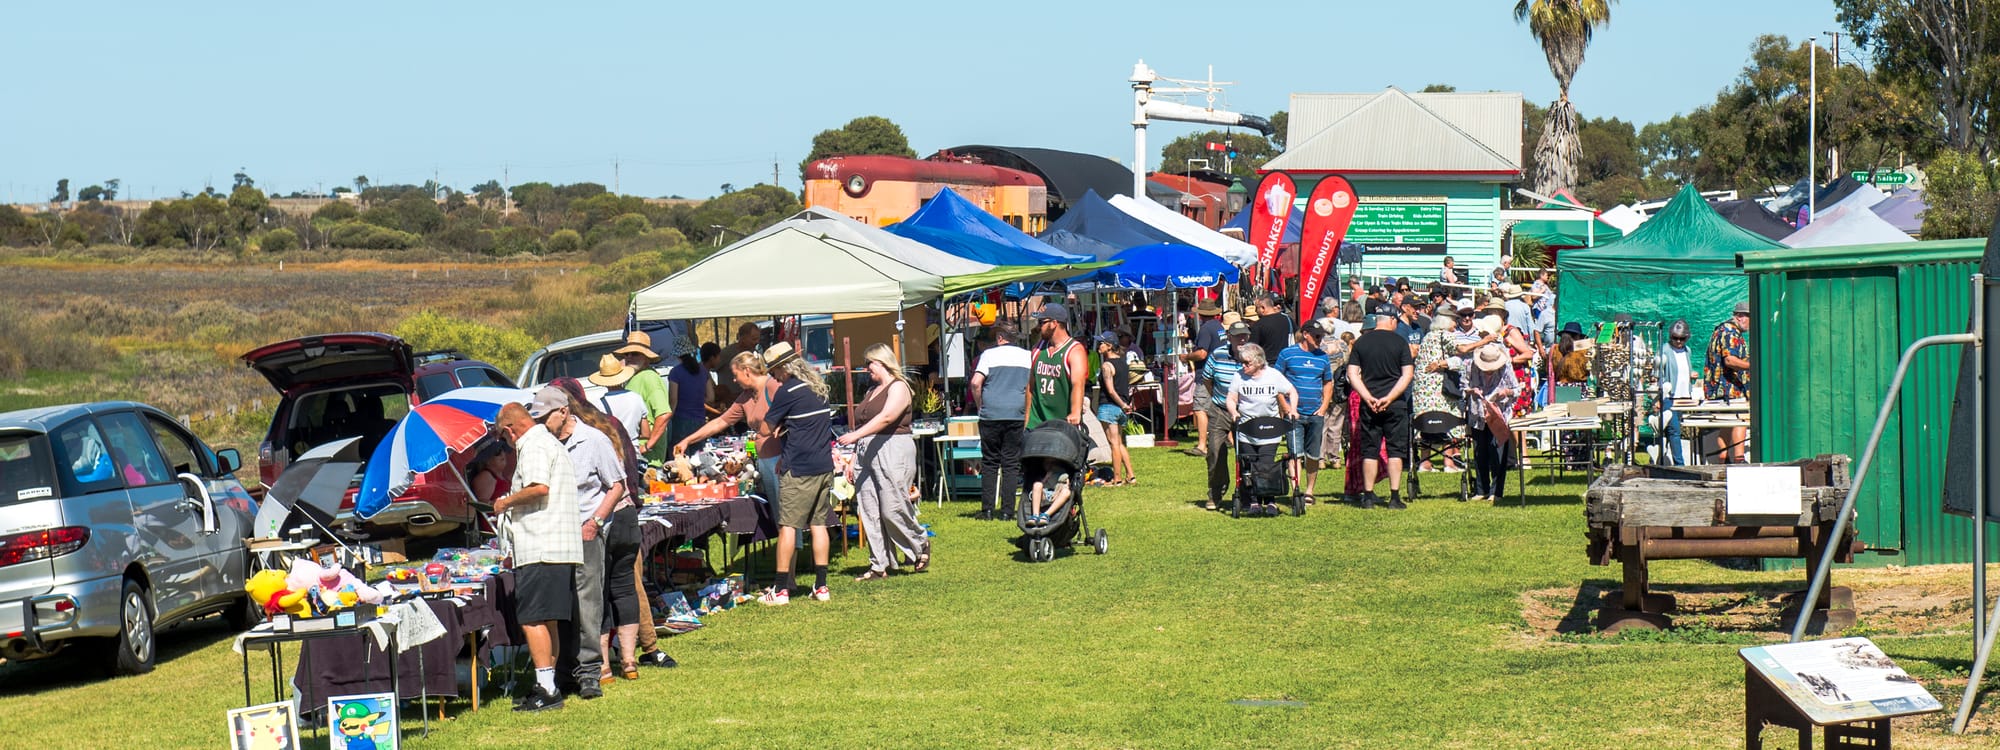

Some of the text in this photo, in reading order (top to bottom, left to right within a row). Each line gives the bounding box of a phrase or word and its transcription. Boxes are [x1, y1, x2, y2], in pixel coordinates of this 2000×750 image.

[1304, 230, 1335, 298] HOT DONUTS
[1036, 361, 1061, 377] BUCKS
[1040, 378, 1055, 395] 34
